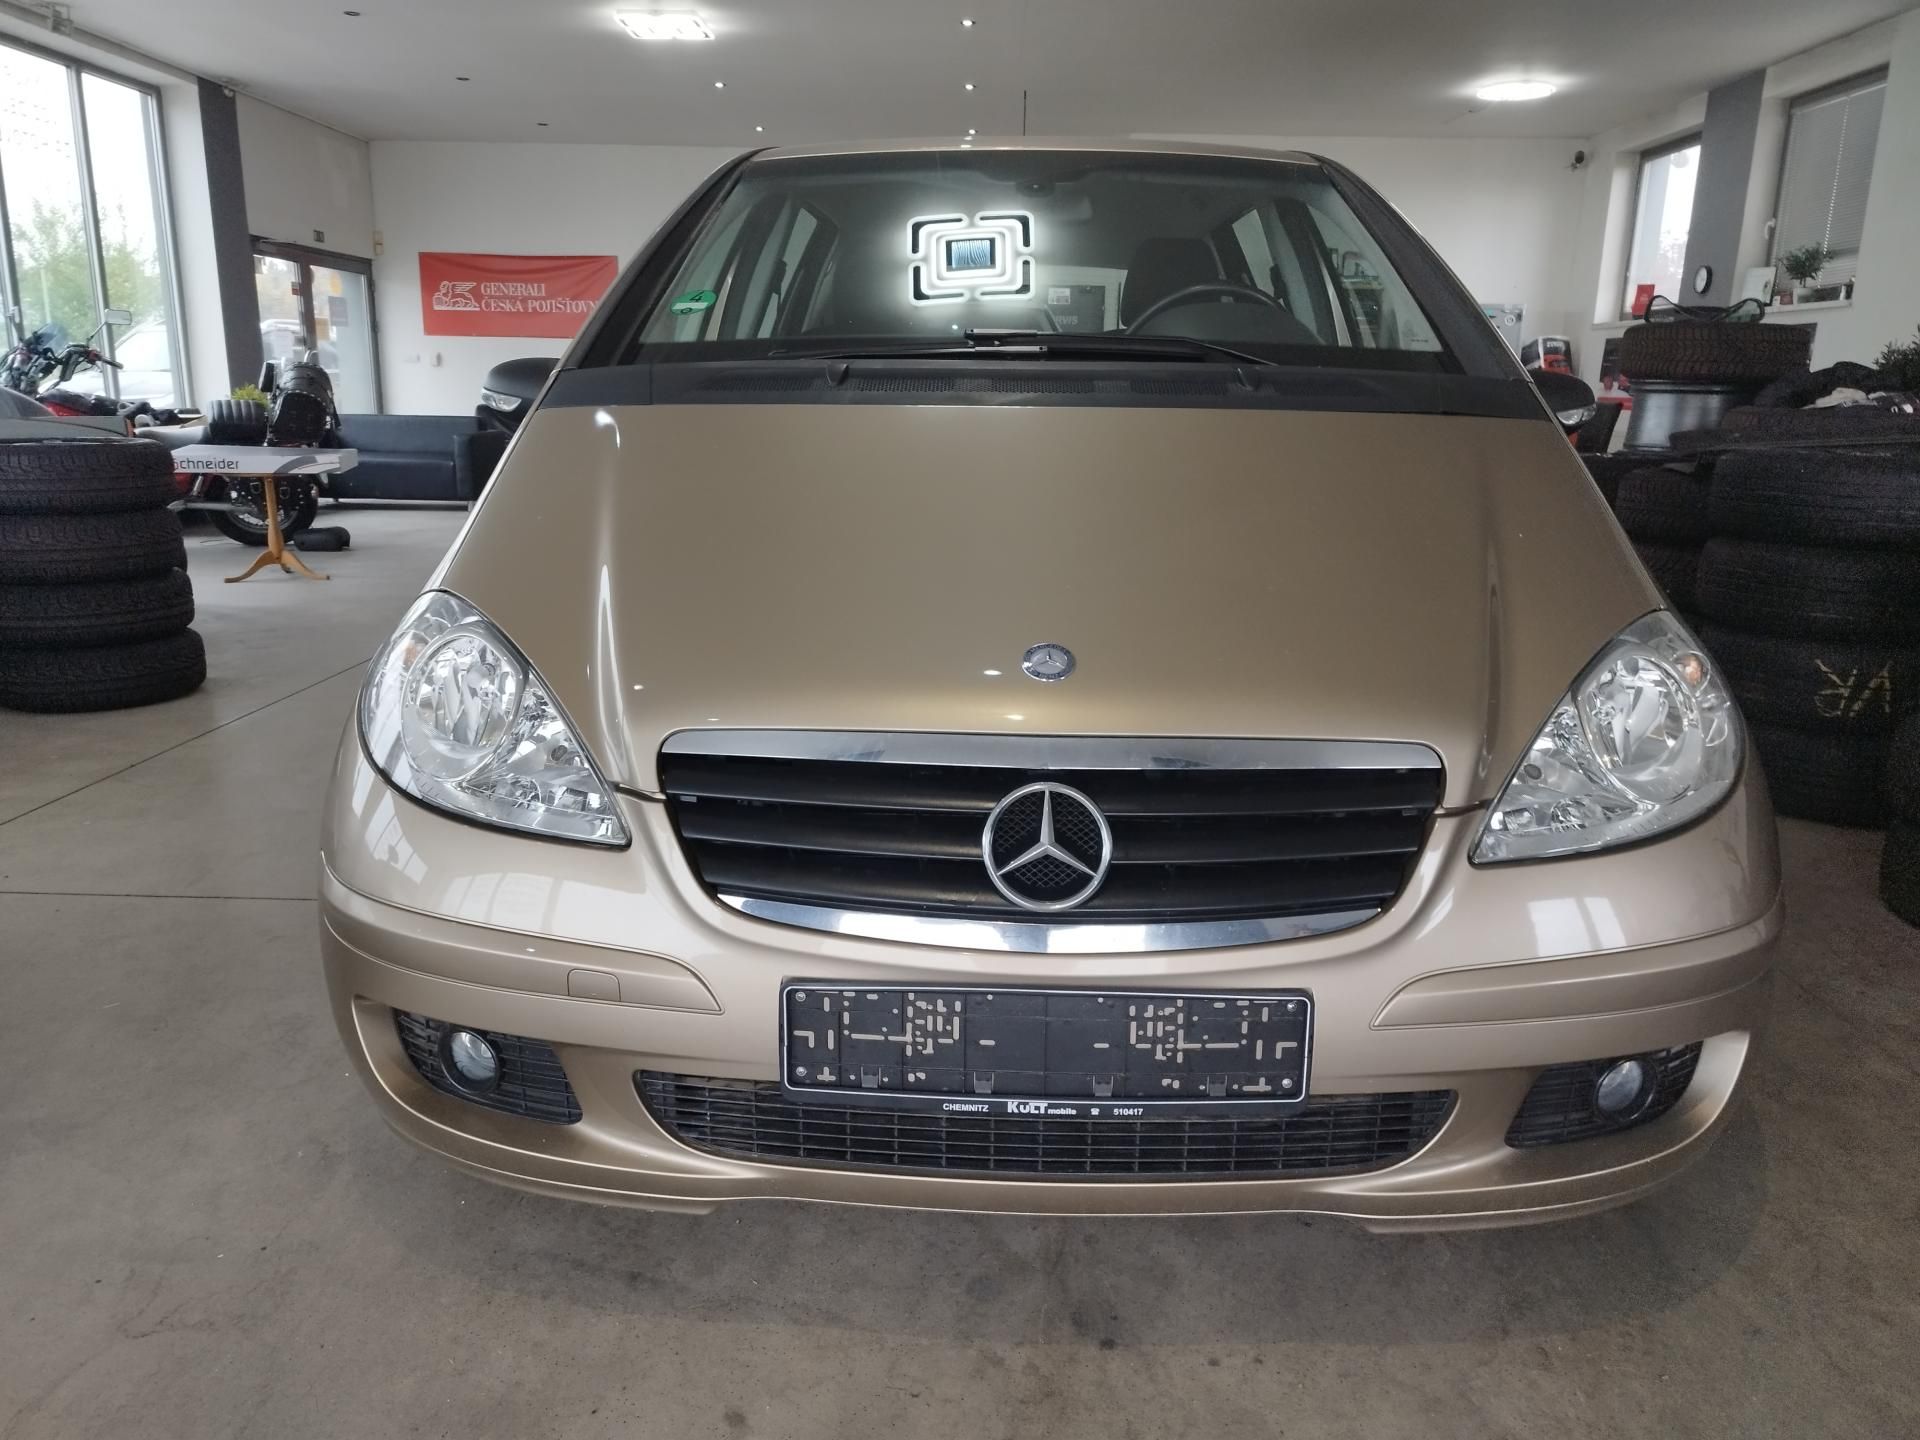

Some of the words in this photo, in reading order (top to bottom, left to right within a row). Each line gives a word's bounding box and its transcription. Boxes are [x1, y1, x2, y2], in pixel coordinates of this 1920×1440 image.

[480, 282, 546, 297] GENERALI
[689, 290, 705, 302] 4
[480, 296, 524, 313] ČESKÁ
[942, 1103, 990, 1113] CHEMNITZ
[1113, 1108, 1144, 1116] 510417
